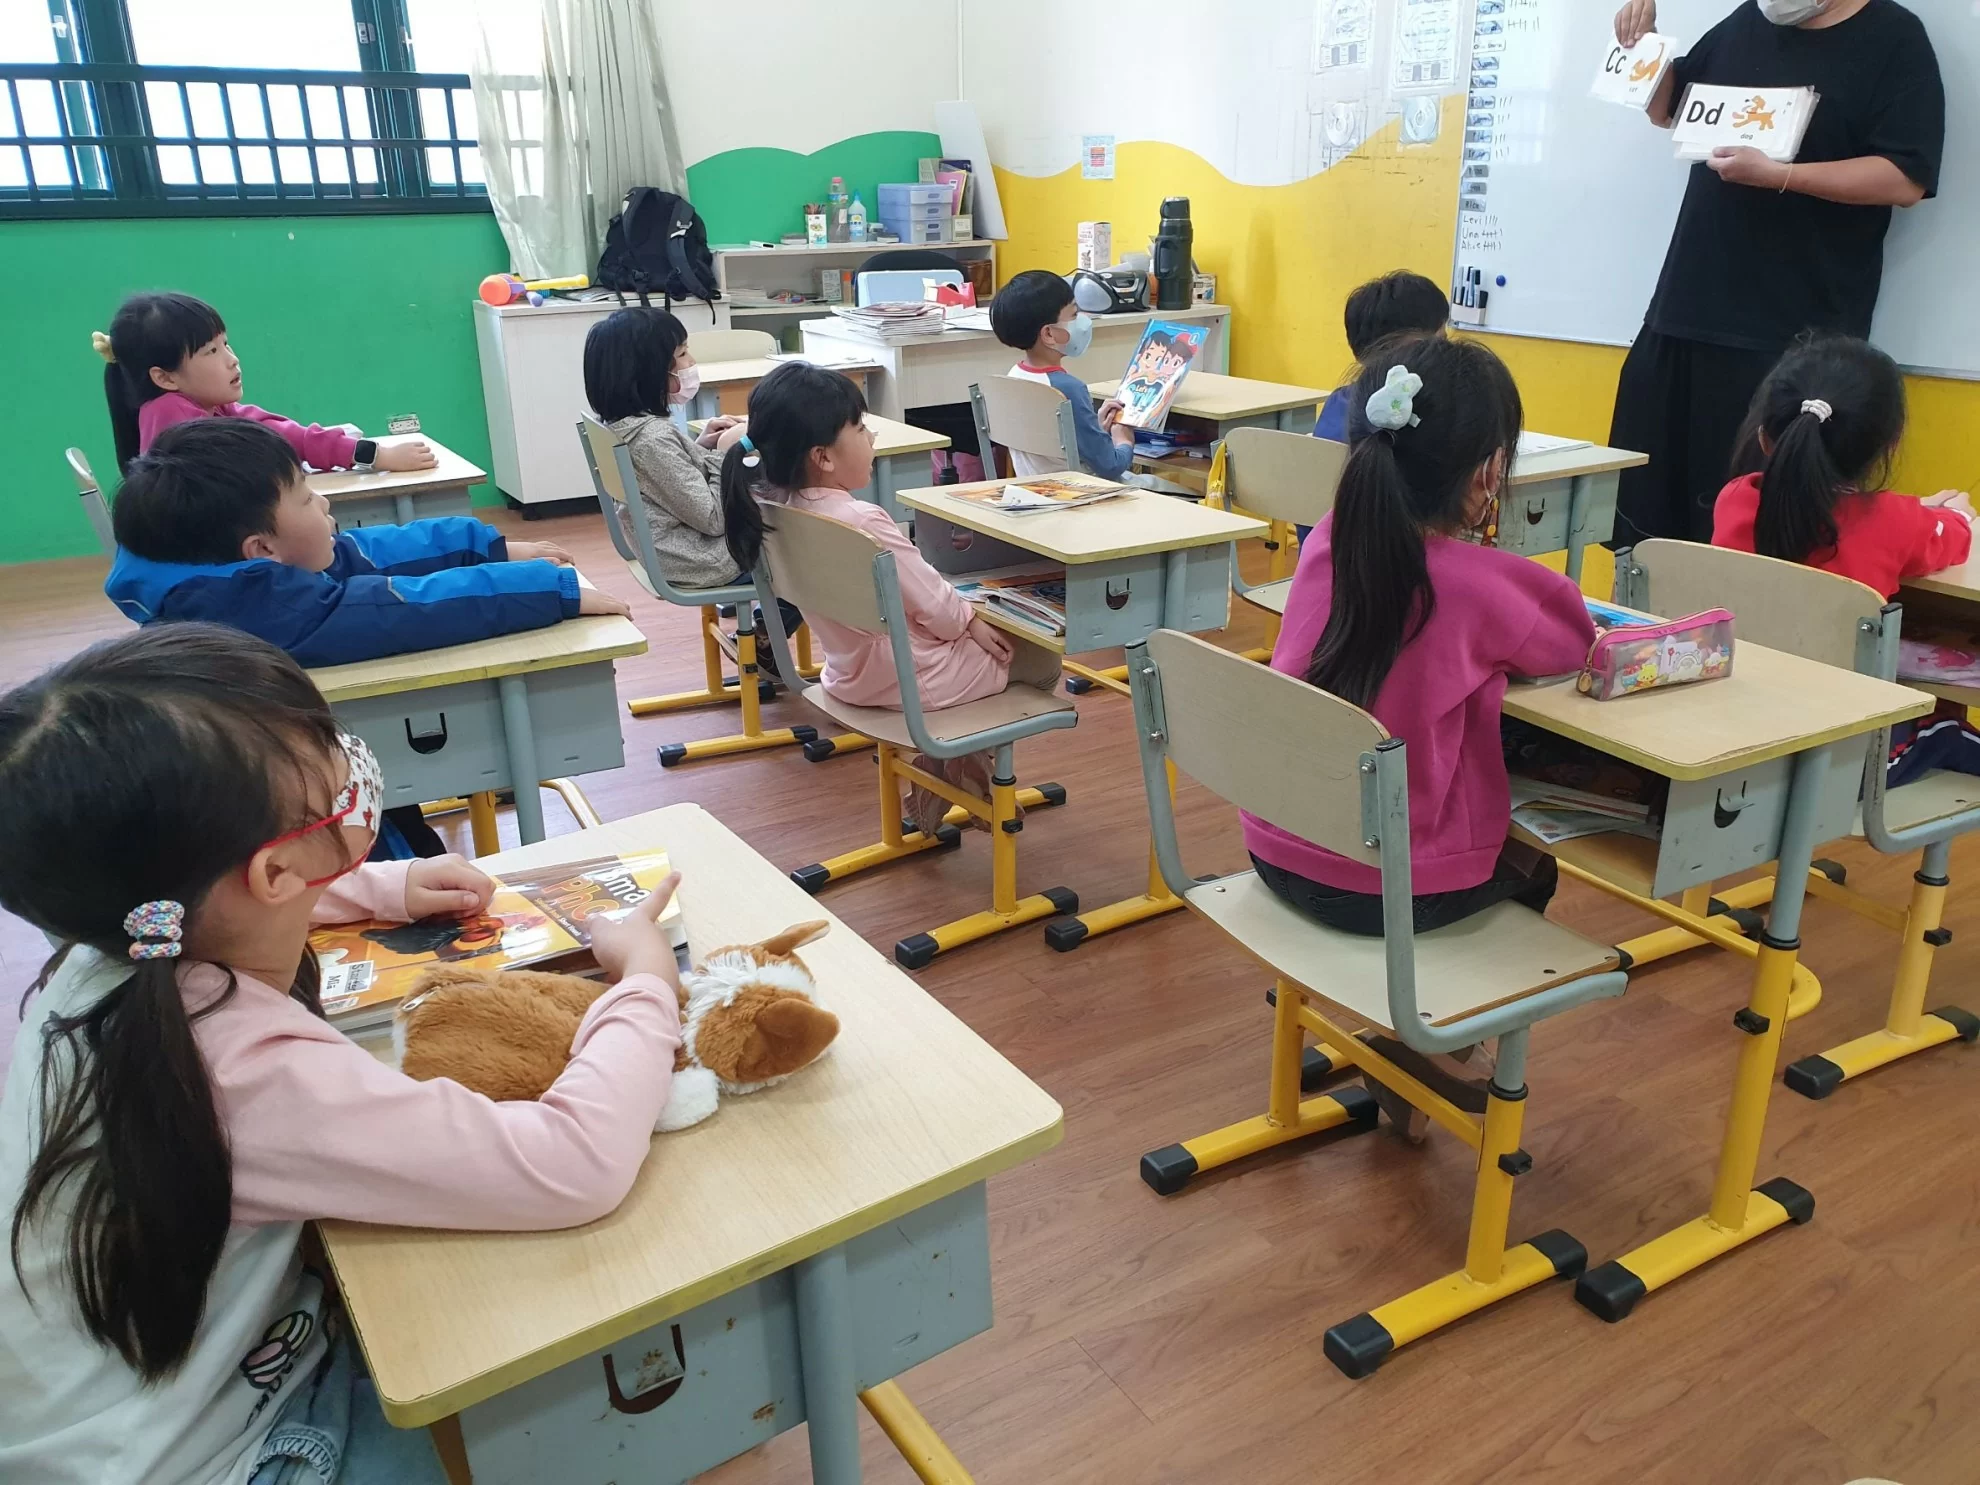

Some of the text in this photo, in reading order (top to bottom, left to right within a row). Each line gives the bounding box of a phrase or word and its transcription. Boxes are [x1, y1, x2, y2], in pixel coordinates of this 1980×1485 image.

[1605, 46, 1627, 74] Cc
[1686, 100, 1725, 126] Dd
[1740, 132, 1754, 141] dog
